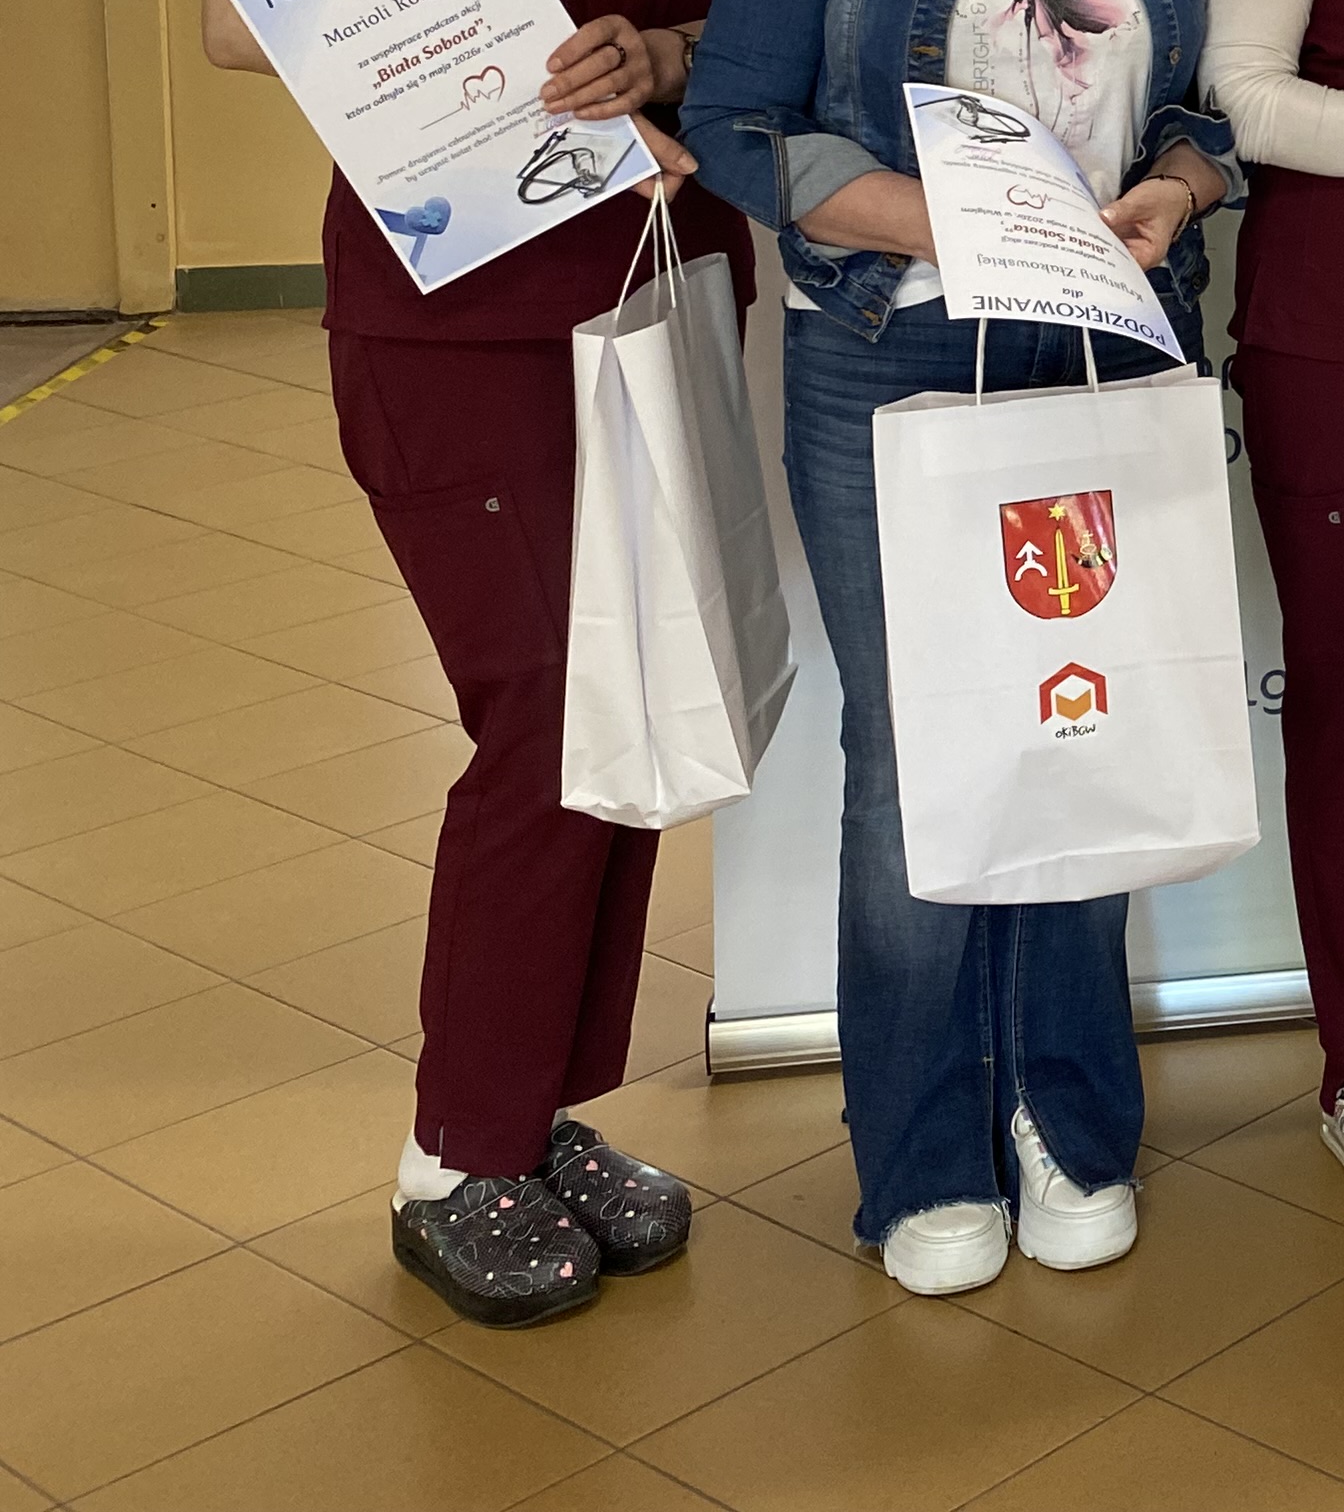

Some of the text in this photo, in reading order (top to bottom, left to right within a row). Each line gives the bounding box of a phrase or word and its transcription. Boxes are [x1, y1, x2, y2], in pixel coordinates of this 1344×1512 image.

[322, 3, 391, 46] Marioli
[421, 11, 458, 34] podczas
[344, 102, 370, 119] która
[418, 73, 427, 82] 9
[427, 62, 451, 79] maja
[493, 18, 534, 44] Wielgiem
[367, 52, 422, 87] „Biała
[1062, 288, 1083, 298] dla
[972, 296, 1165, 345] PODZIĘKOWANIE
